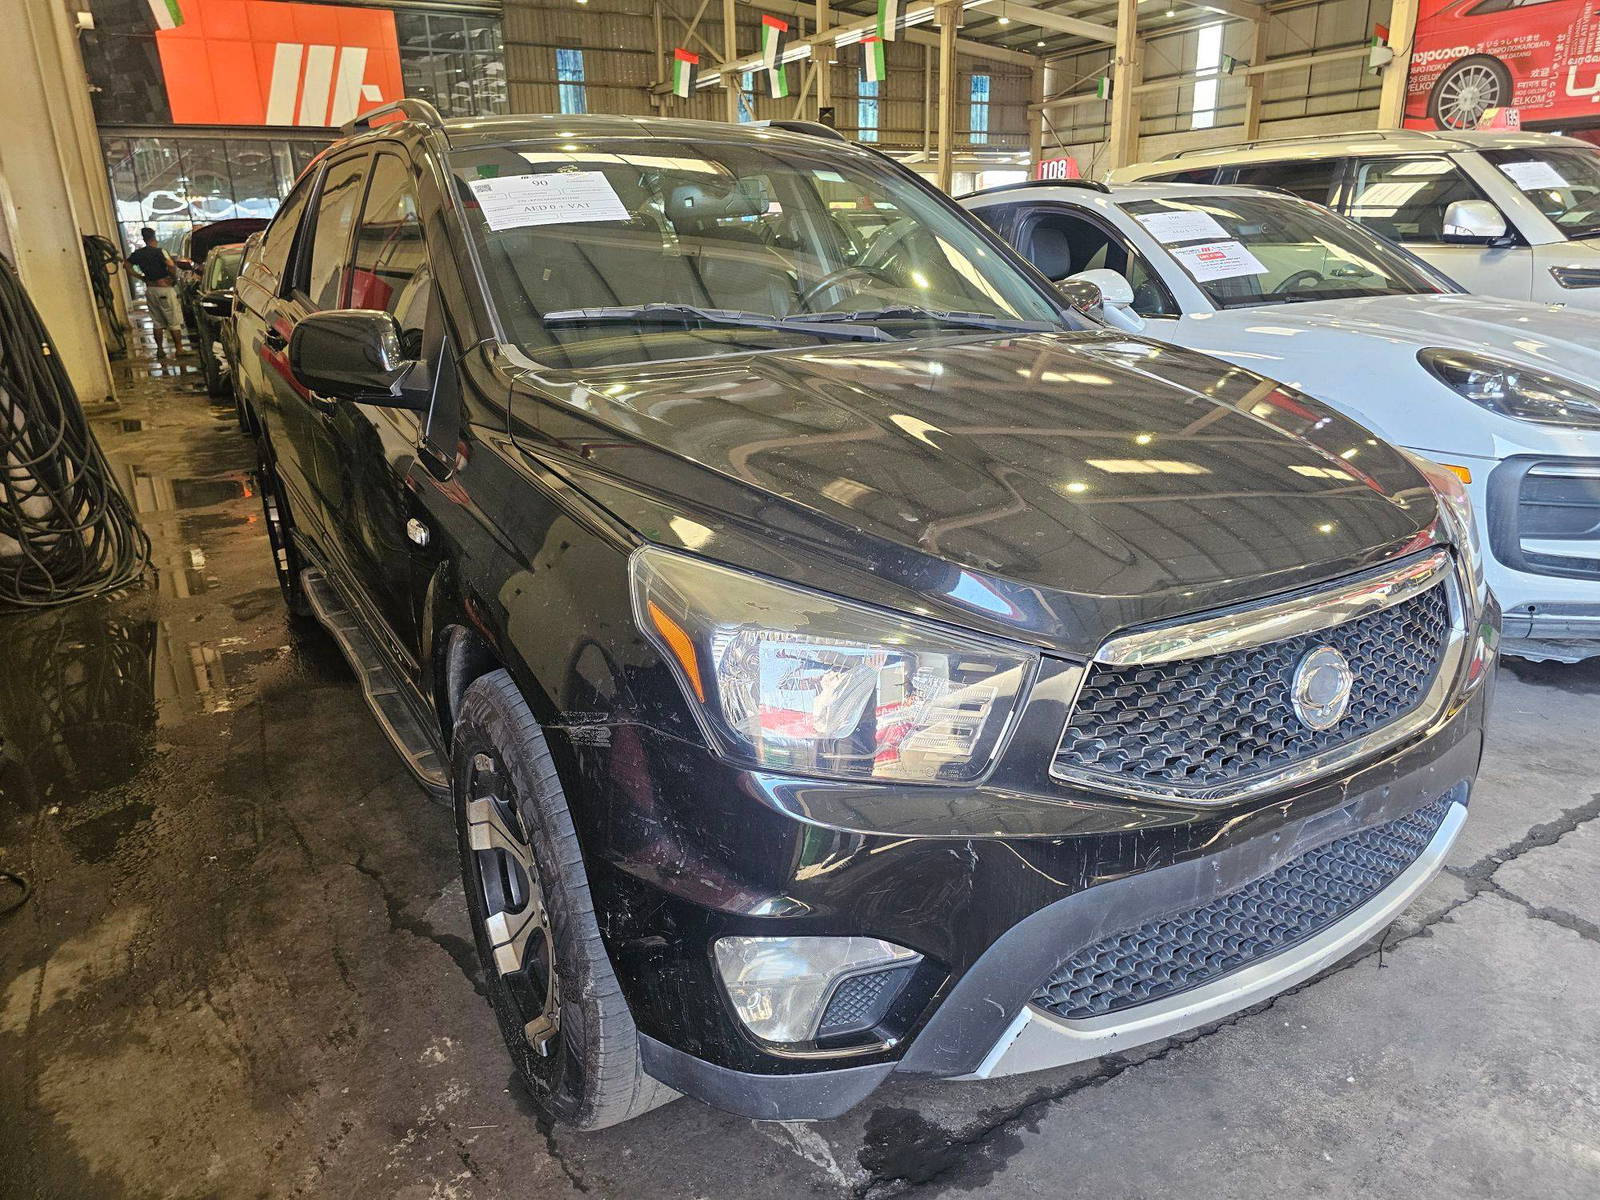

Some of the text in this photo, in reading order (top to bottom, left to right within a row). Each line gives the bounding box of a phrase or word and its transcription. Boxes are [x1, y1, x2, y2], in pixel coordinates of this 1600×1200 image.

[1042, 159, 1067, 180] 108
[531, 179, 549, 187] 90
[524, 204, 547, 212] AED
[567, 202, 592, 210] VAT
